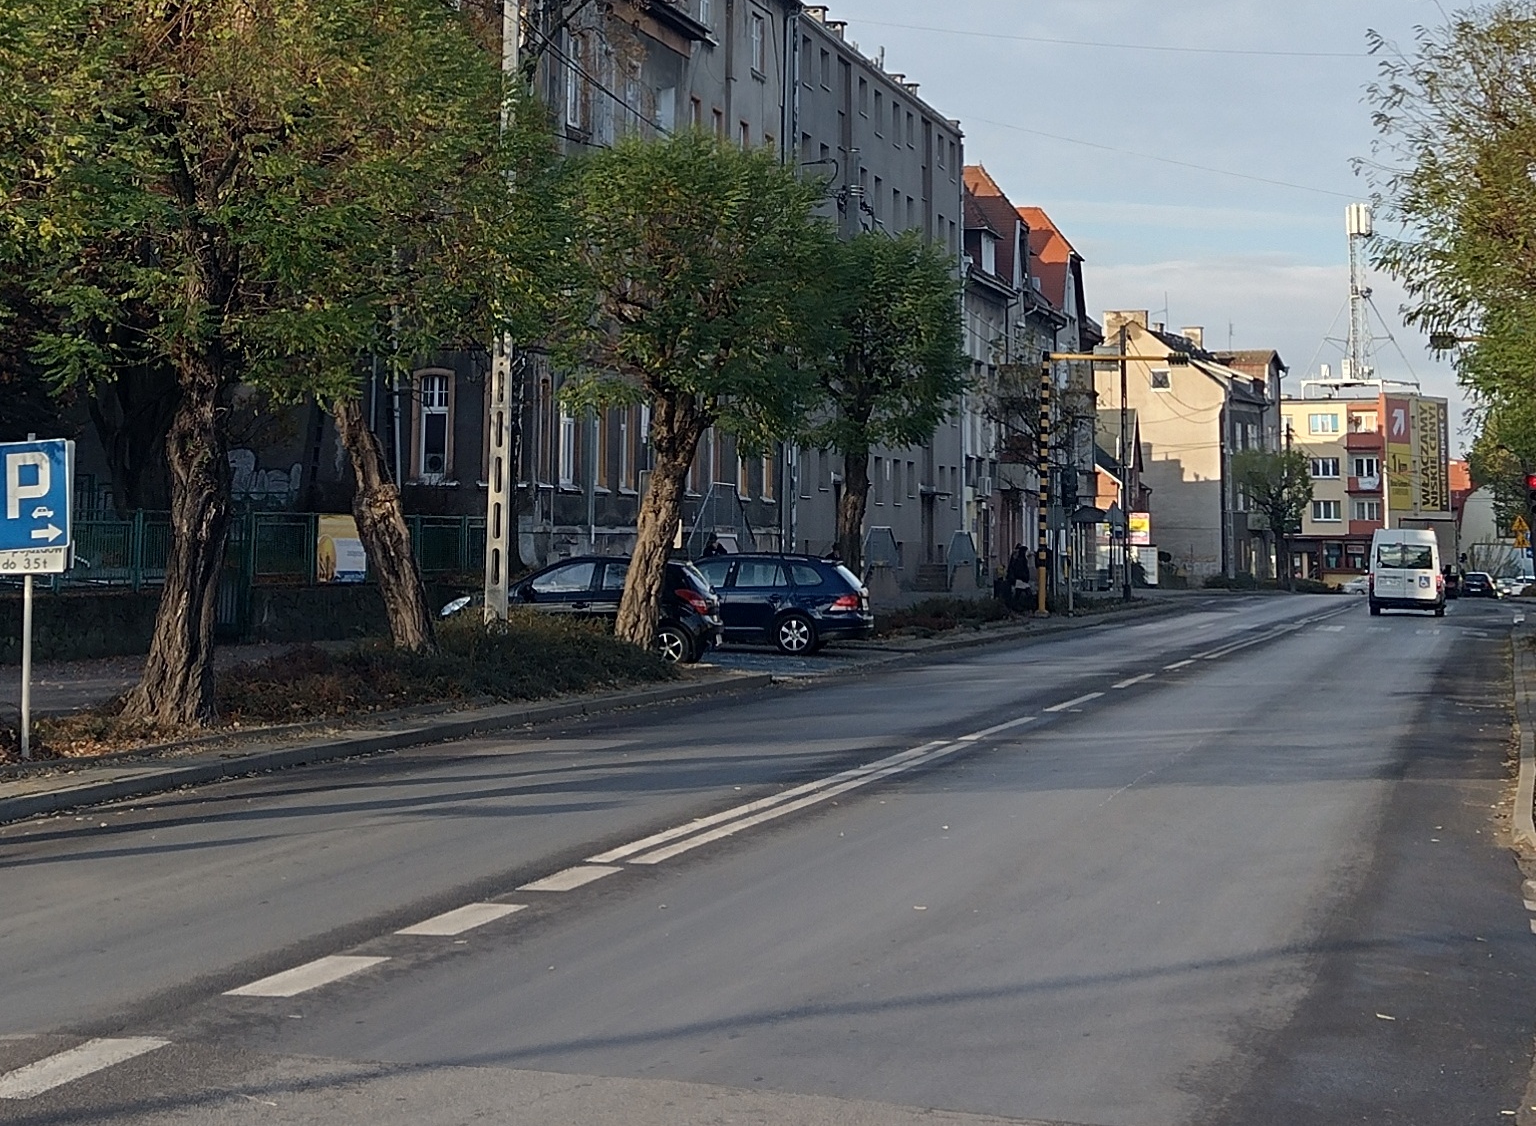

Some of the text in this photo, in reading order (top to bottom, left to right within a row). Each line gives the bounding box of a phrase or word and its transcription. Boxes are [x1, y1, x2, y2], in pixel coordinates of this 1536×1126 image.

[6, 452, 50, 519] P
[2, 559, 17, 570] do
[42, 559, 48, 569] t
